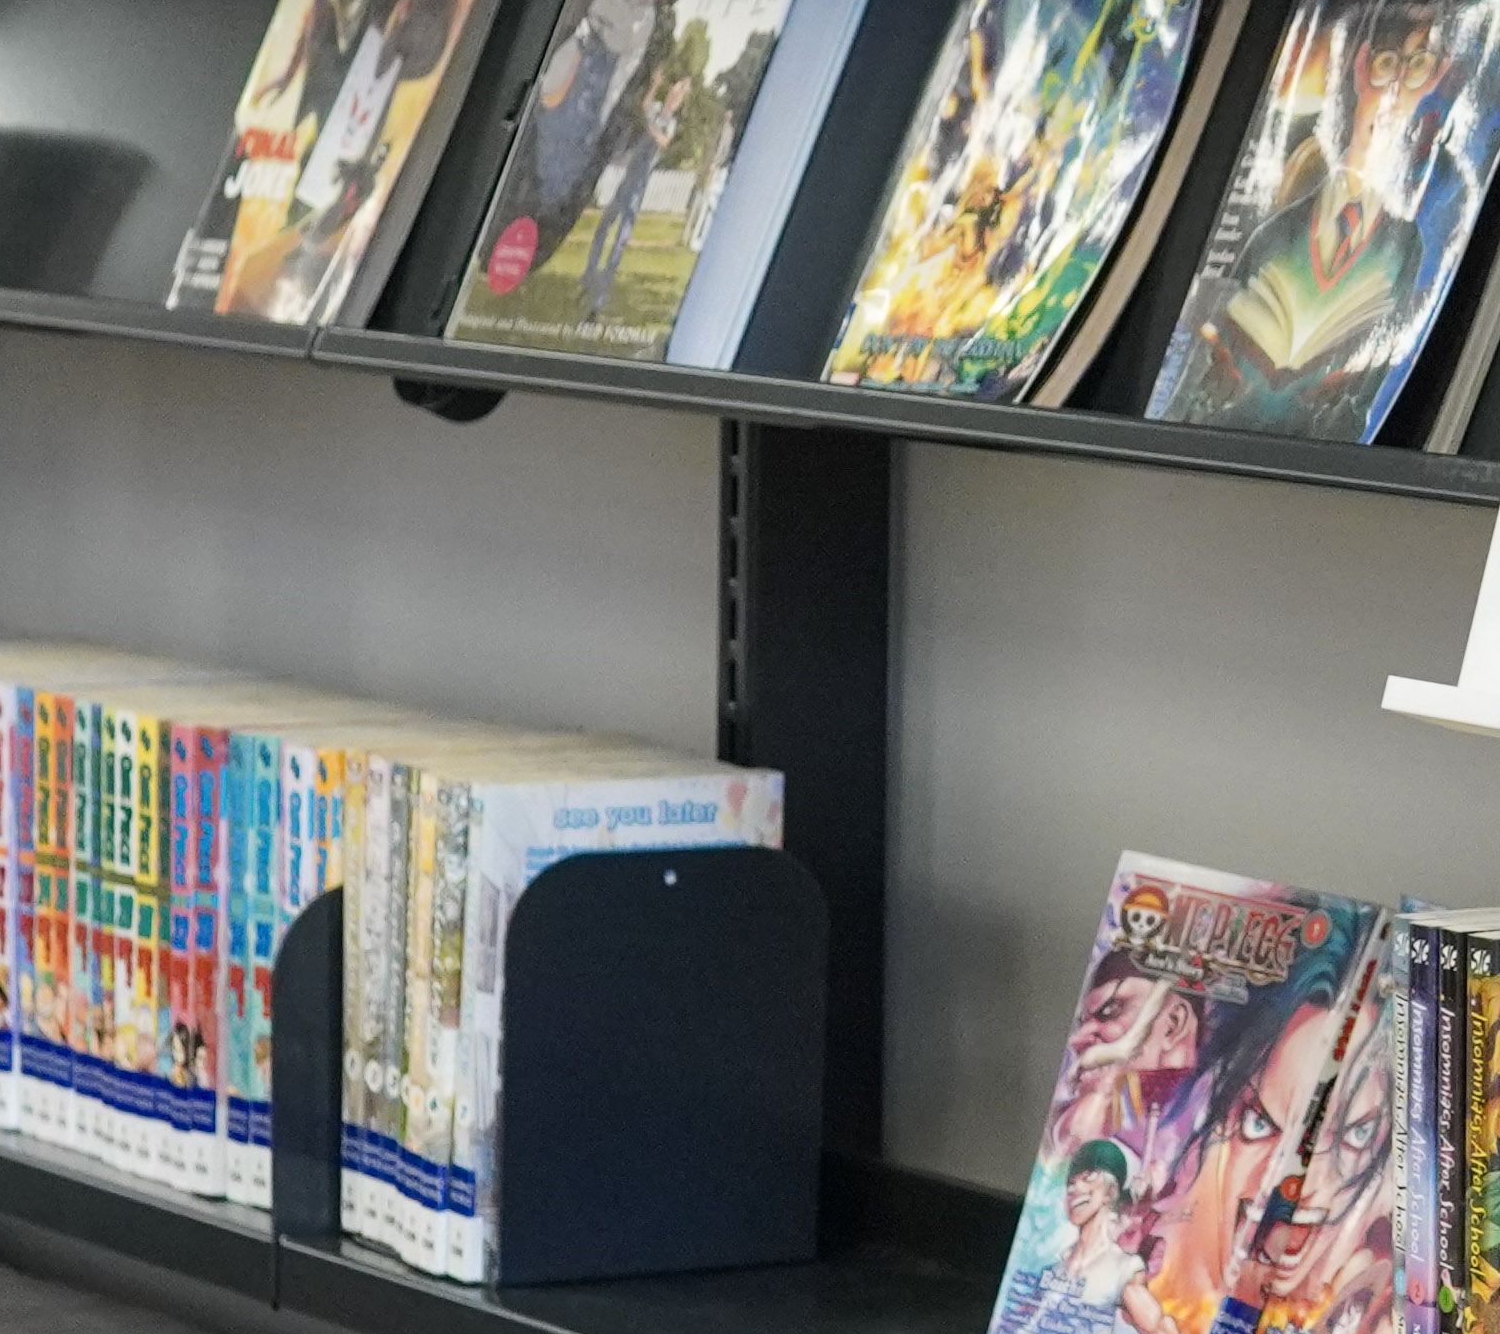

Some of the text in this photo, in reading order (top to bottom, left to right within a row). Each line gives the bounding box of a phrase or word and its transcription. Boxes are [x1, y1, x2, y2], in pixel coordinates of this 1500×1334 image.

[238, 128, 299, 161] FINAL
[605, 805, 652, 831] you
[1470, 1011, 1488, 1280] Insomniacs After School
